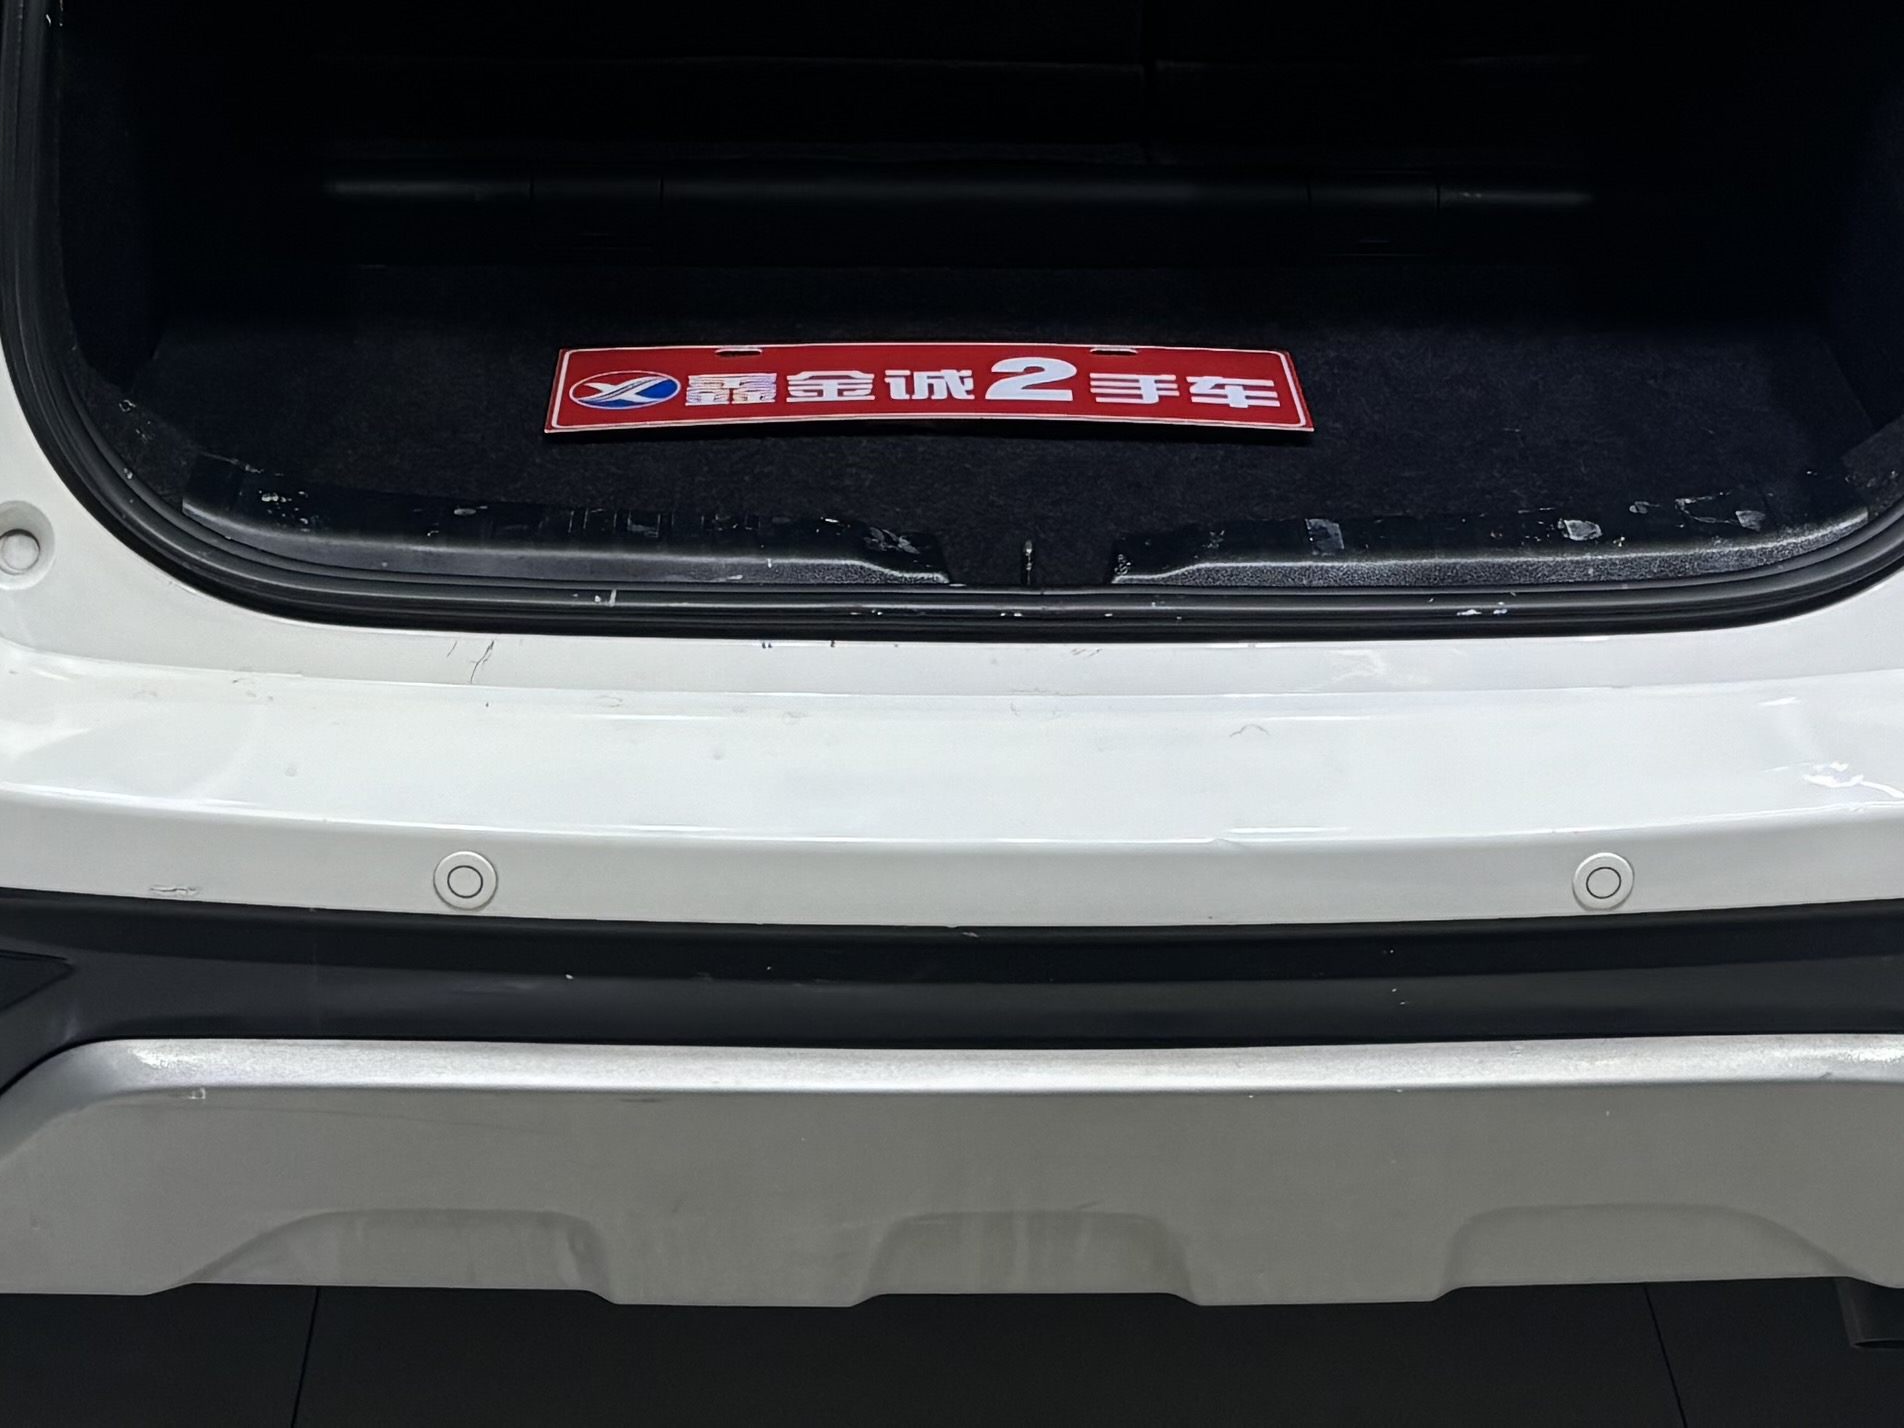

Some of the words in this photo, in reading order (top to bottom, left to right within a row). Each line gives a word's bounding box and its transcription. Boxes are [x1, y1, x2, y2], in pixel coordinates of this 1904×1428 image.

[684, 356, 1282, 409] 鑫金诚2手车
